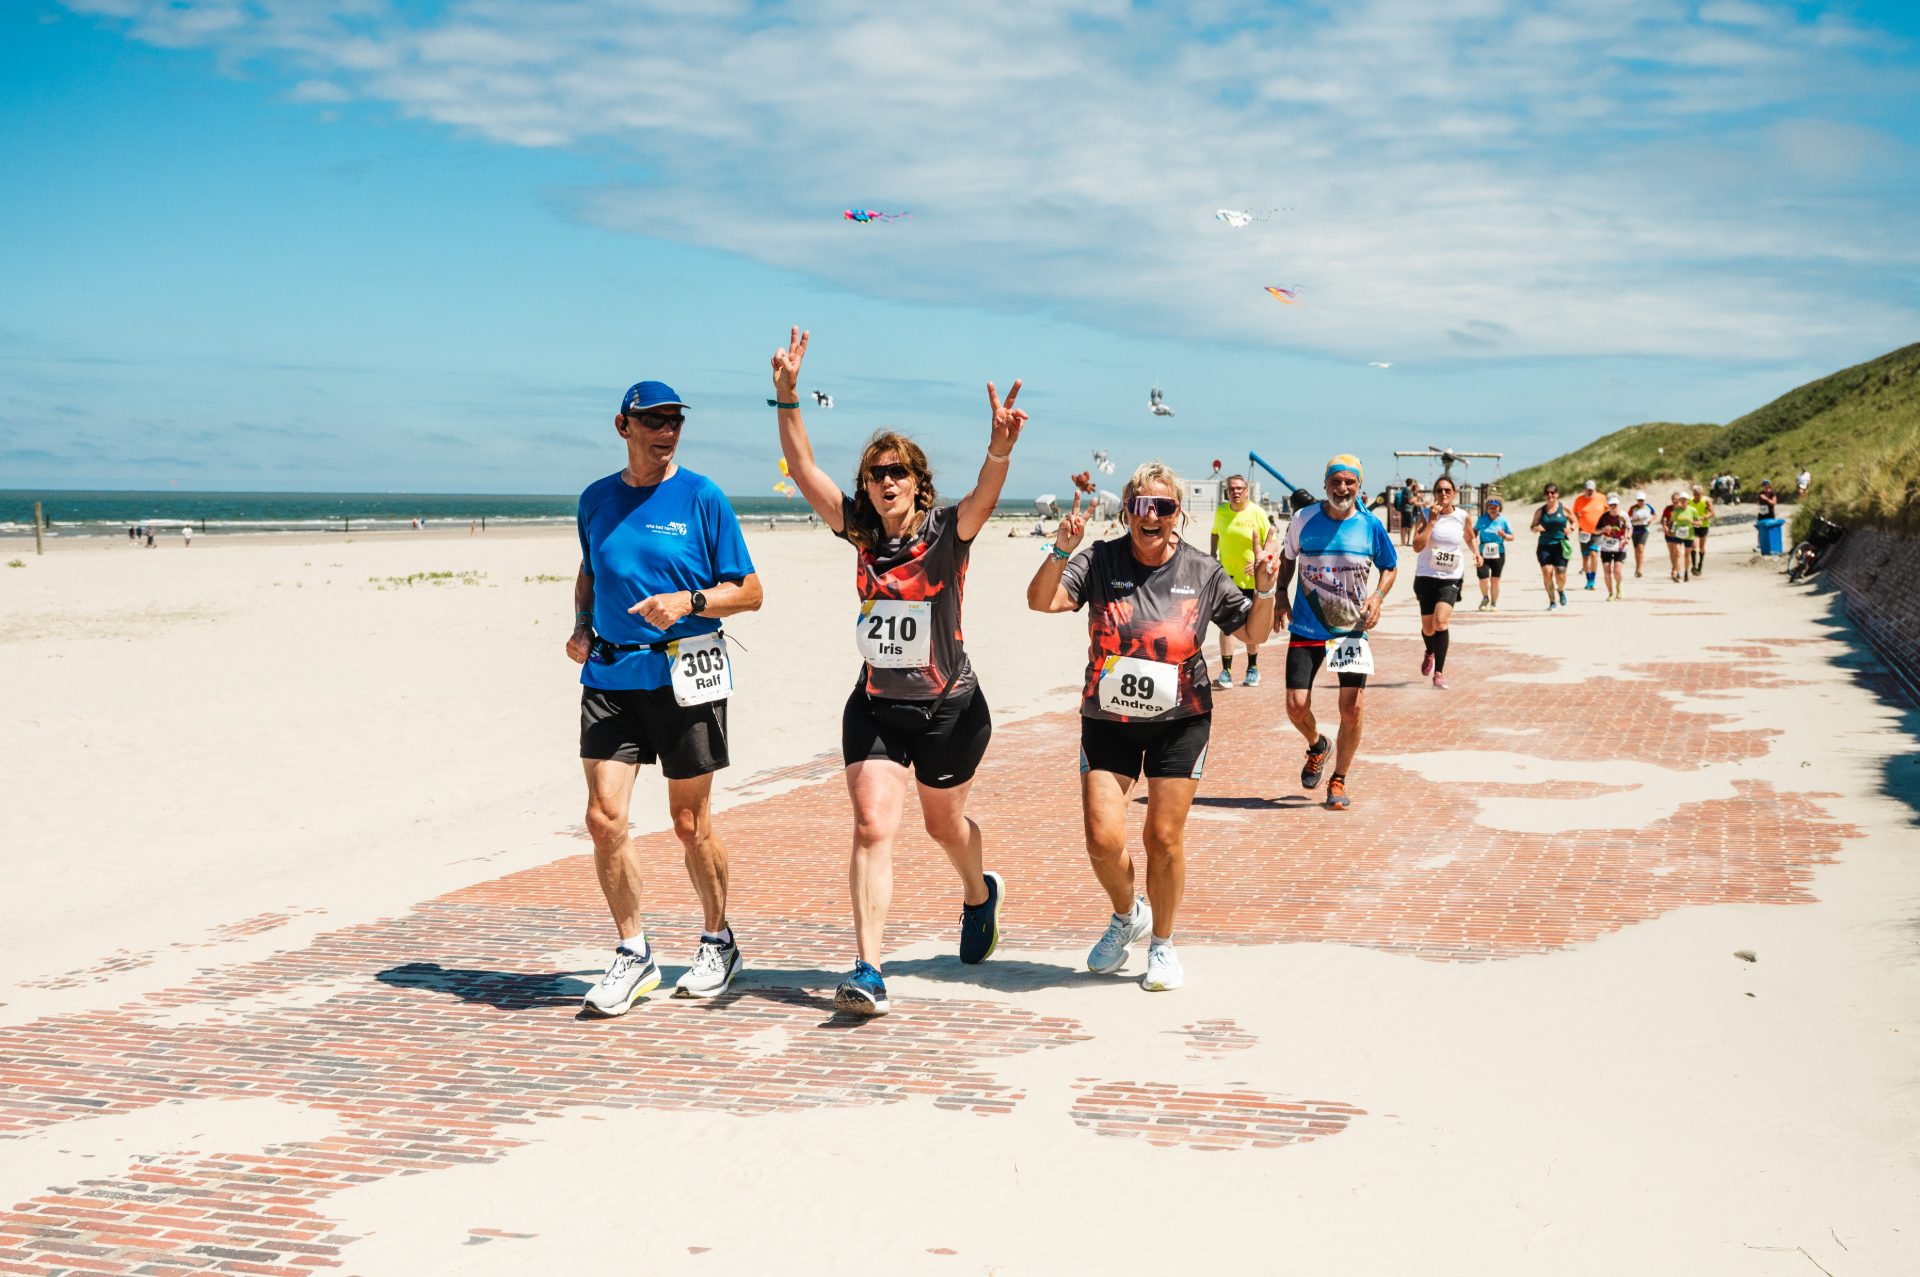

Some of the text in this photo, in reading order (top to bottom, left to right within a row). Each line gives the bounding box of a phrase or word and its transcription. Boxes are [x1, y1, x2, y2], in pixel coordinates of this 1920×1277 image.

[1436, 551, 1455, 562] 381
[868, 615, 916, 641] 210
[879, 643, 902, 654] Iris
[1335, 645, 1362, 660] 141
[682, 647, 723, 677] 303
[695, 674, 721, 690] Ralf
[1120, 674, 1154, 700] 89
[1110, 696, 1163, 712] Andrea
